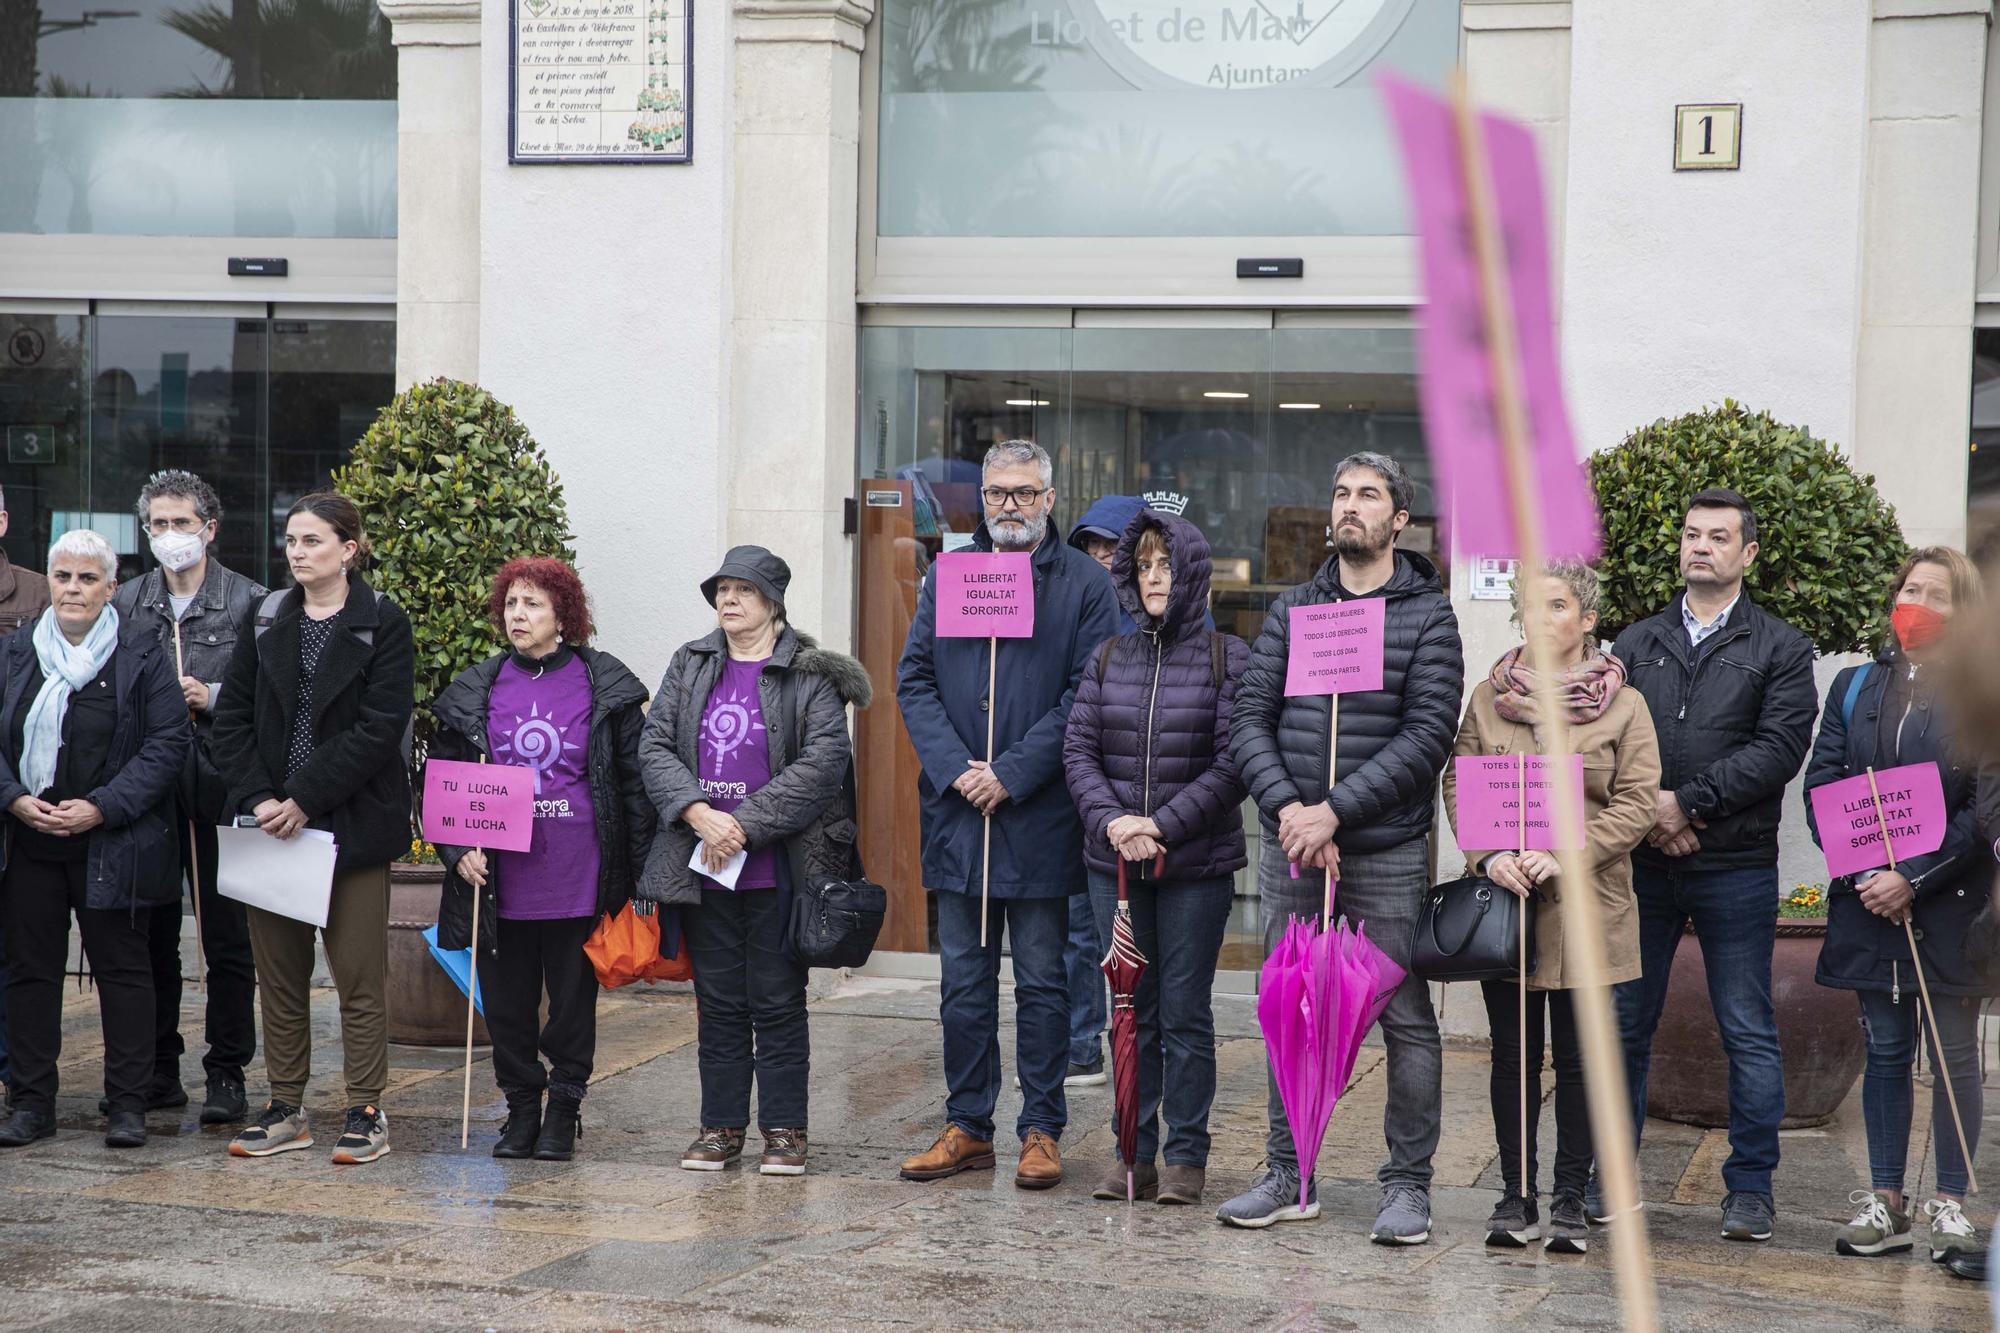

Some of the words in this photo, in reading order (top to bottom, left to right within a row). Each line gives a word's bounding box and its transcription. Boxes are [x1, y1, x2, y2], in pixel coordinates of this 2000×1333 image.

[550, 6, 558, 16] el
[560, 7, 570, 16] 30
[572, 7, 580, 16] de
[584, 8, 600, 17] juny
[601, 6, 610, 15] de
[522, 24, 533, 33] els
[536, 24, 576, 33] Castellers
[578, 24, 588, 32] de
[1030, 9, 1144, 45] Lloet
[1156, 7, 1206, 43] de
[540, 40, 575, 49] carregar
[586, 38, 634, 48] descarregar
[522, 55, 532, 63] el
[554, 55, 564, 63] de
[586, 55, 605, 63] amb
[536, 72, 544, 80] el
[546, 72, 577, 82] primer
[580, 70, 608, 80] castell
[1207, 63, 1310, 90] Ajuntam
[529, 86, 538, 94] de
[560, 86, 582, 96] pisos
[585, 86, 616, 96] plantat
[546, 100, 555, 109] la
[535, 116, 546, 124] de
[550, 116, 558, 124] la
[562, 114, 586, 124] Selva
[1698, 116, 1716, 154] 1
[520, 142, 541, 151] Lloret
[543, 143, 551, 151] de
[586, 143, 594, 151] de
[612, 142, 620, 152] de
[24, 432, 39, 456] 3
[964, 574, 1017, 583] LLIBERTAT
[966, 590, 1016, 599] IGUALTAT
[961, 606, 1019, 615] SORORITAT
[1306, 613, 1327, 621] TODAS
[1340, 608, 1365, 618] MUJERES
[1304, 632, 1325, 640] TODOS
[1325, 631, 1337, 639] LOS
[1337, 627, 1368, 637] DERECHOS
[1313, 650, 1332, 658] TODOS
[1344, 647, 1358, 655] DIAS
[1318, 668, 1338, 676] TODAS
[1338, 666, 1360, 674] PARTES
[442, 780, 458, 792] TU
[468, 783, 509, 796] LUCHA
[470, 801, 486, 812] ES
[533, 799, 569, 812] rora
[1843, 789, 1912, 814] LLIBERTAT
[442, 816, 455, 827] MI
[465, 818, 506, 831] LUCHA
